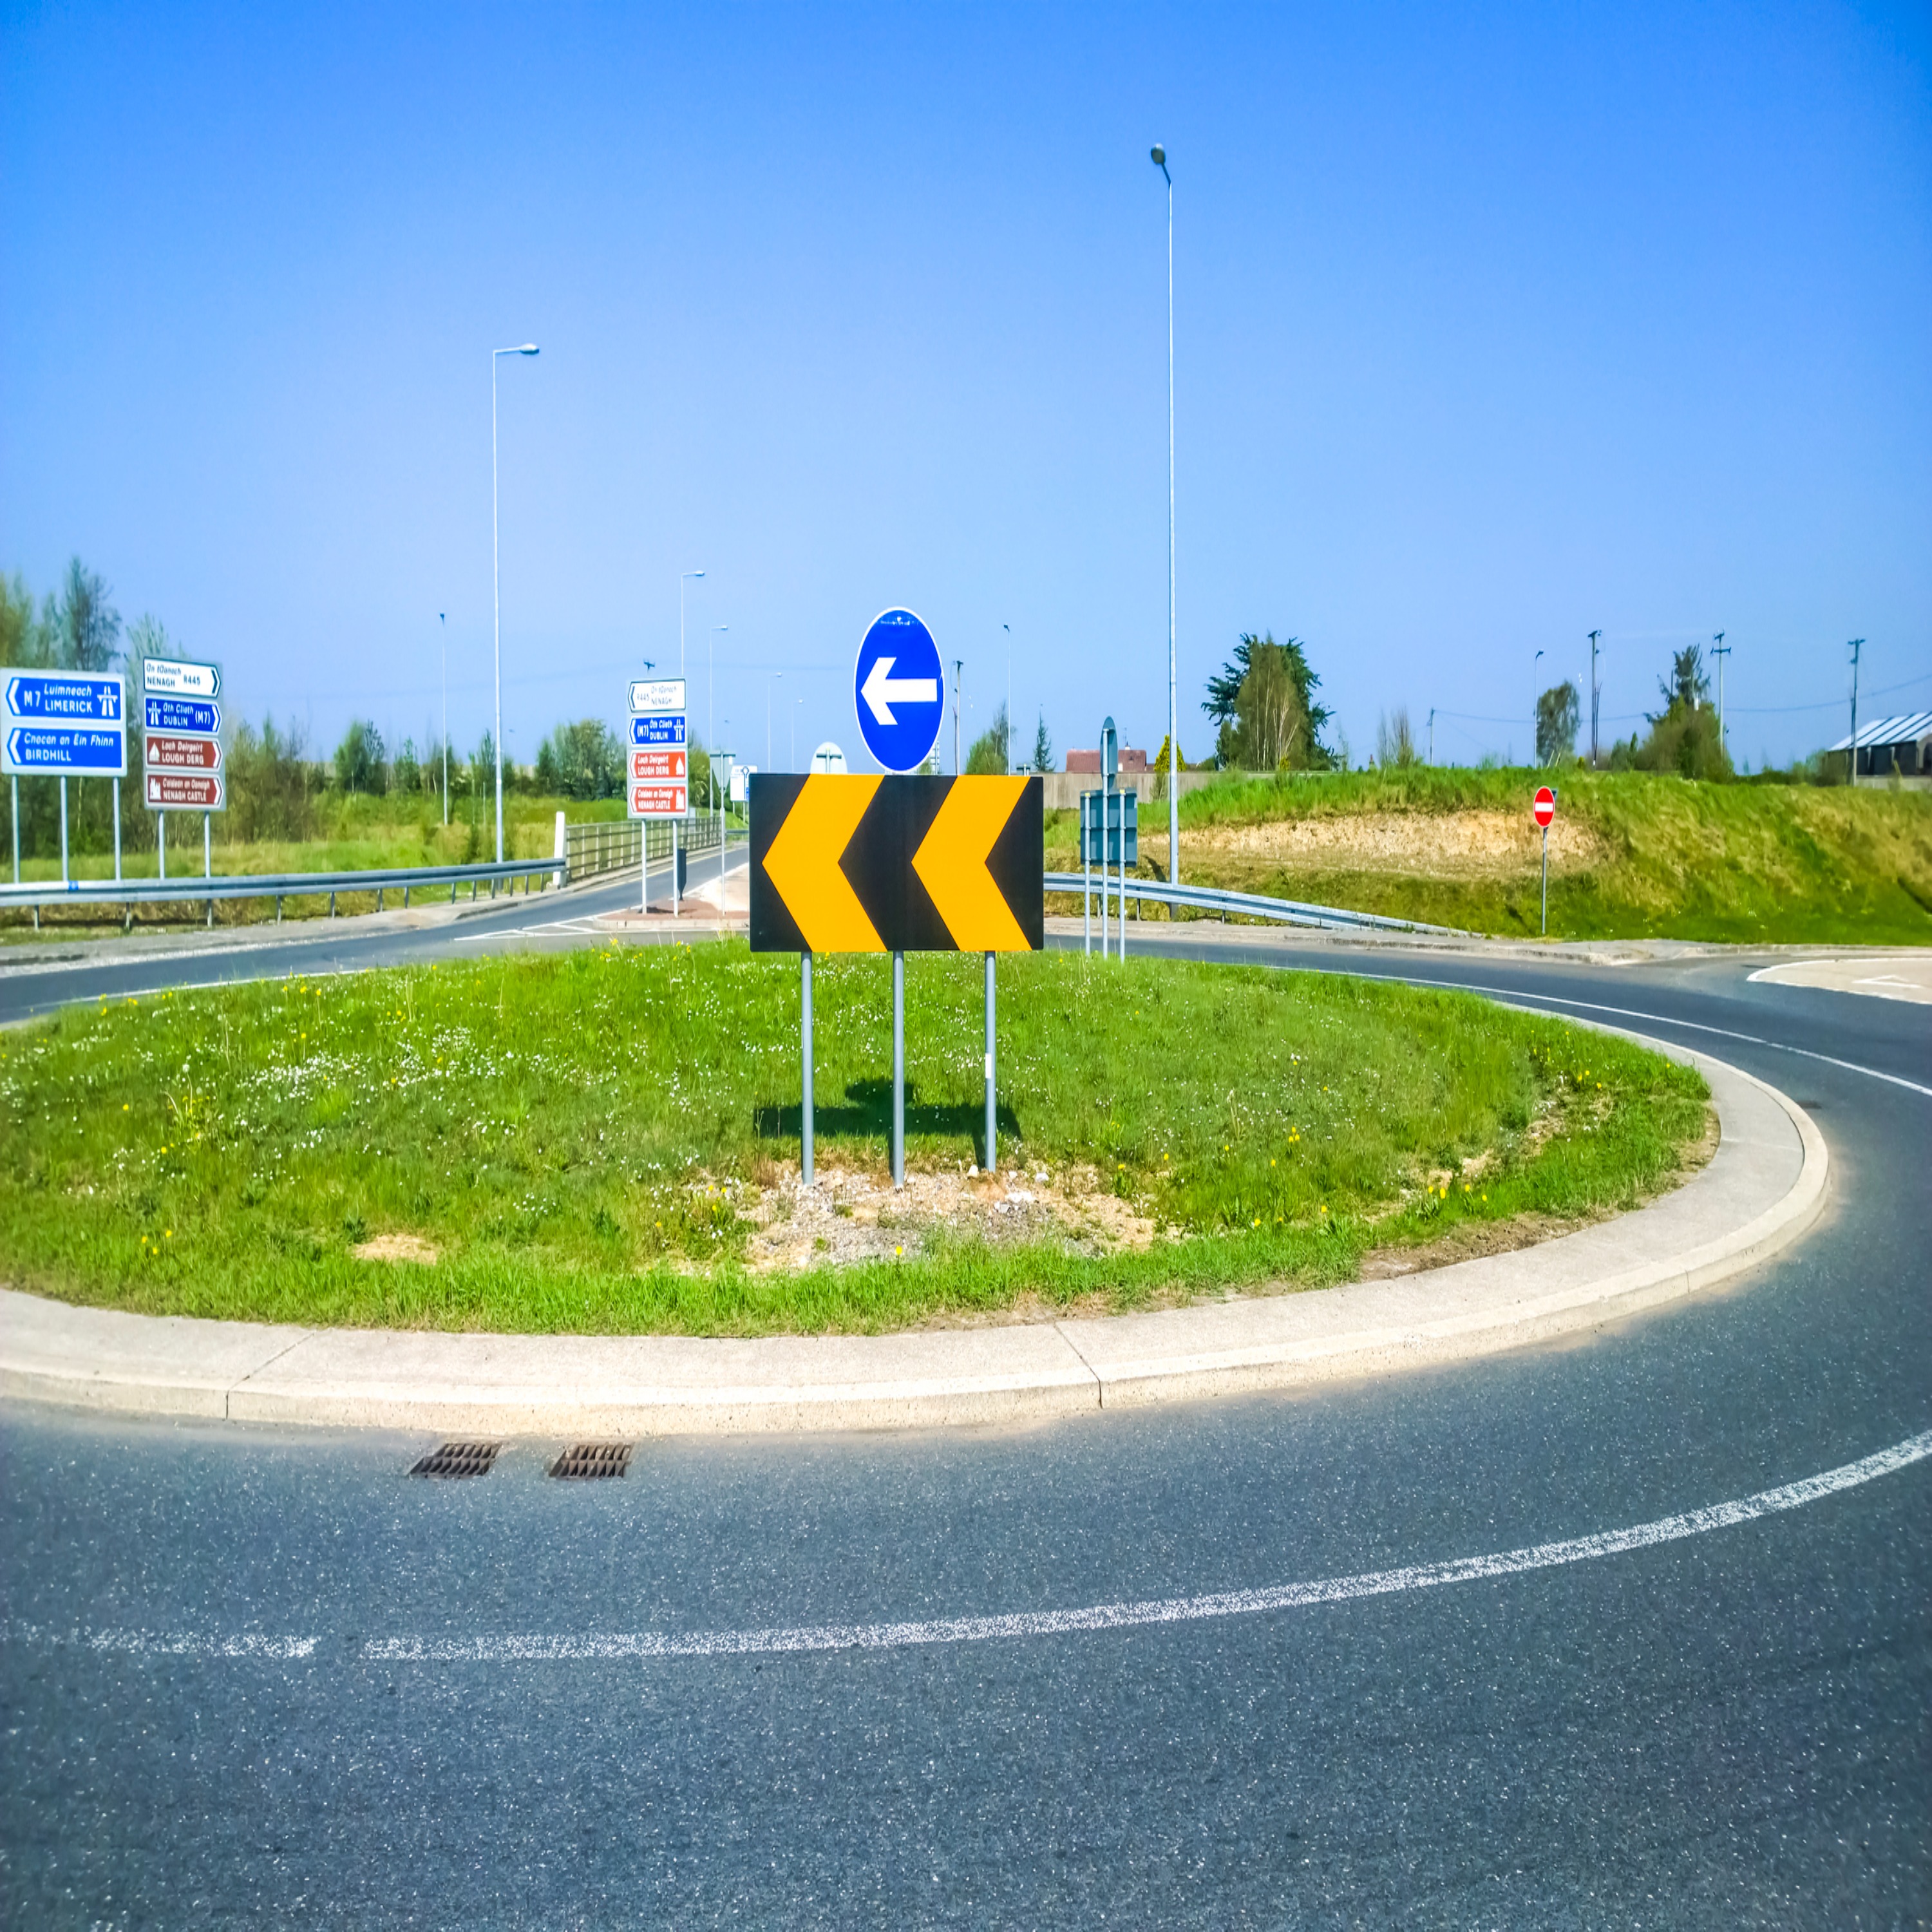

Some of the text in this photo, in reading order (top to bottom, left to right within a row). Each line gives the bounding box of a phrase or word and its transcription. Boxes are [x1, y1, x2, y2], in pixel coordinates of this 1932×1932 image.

[147, 677, 175, 687] NENAGH
[184, 674, 200, 686] R445
[44, 683, 92, 696] Luimneach
[45, 699, 92, 713] LIMERICK
[651, 697, 672, 705] NENAGH
[164, 715, 188, 726] DUBLIN
[60, 735, 70, 745] an
[91, 734, 114, 747] Fhinn
[650, 731, 668, 740] DUBLIN
[162, 740, 175, 751] Loch
[25, 748, 71, 762] BIRDHILL
[162, 752, 204, 765] LOUGH DERG
[638, 766, 669, 776] LOUGH DERG
[163, 790, 207, 802] NENAGH CASTLE
[638, 800, 670, 810] NENAGH CASTLE
